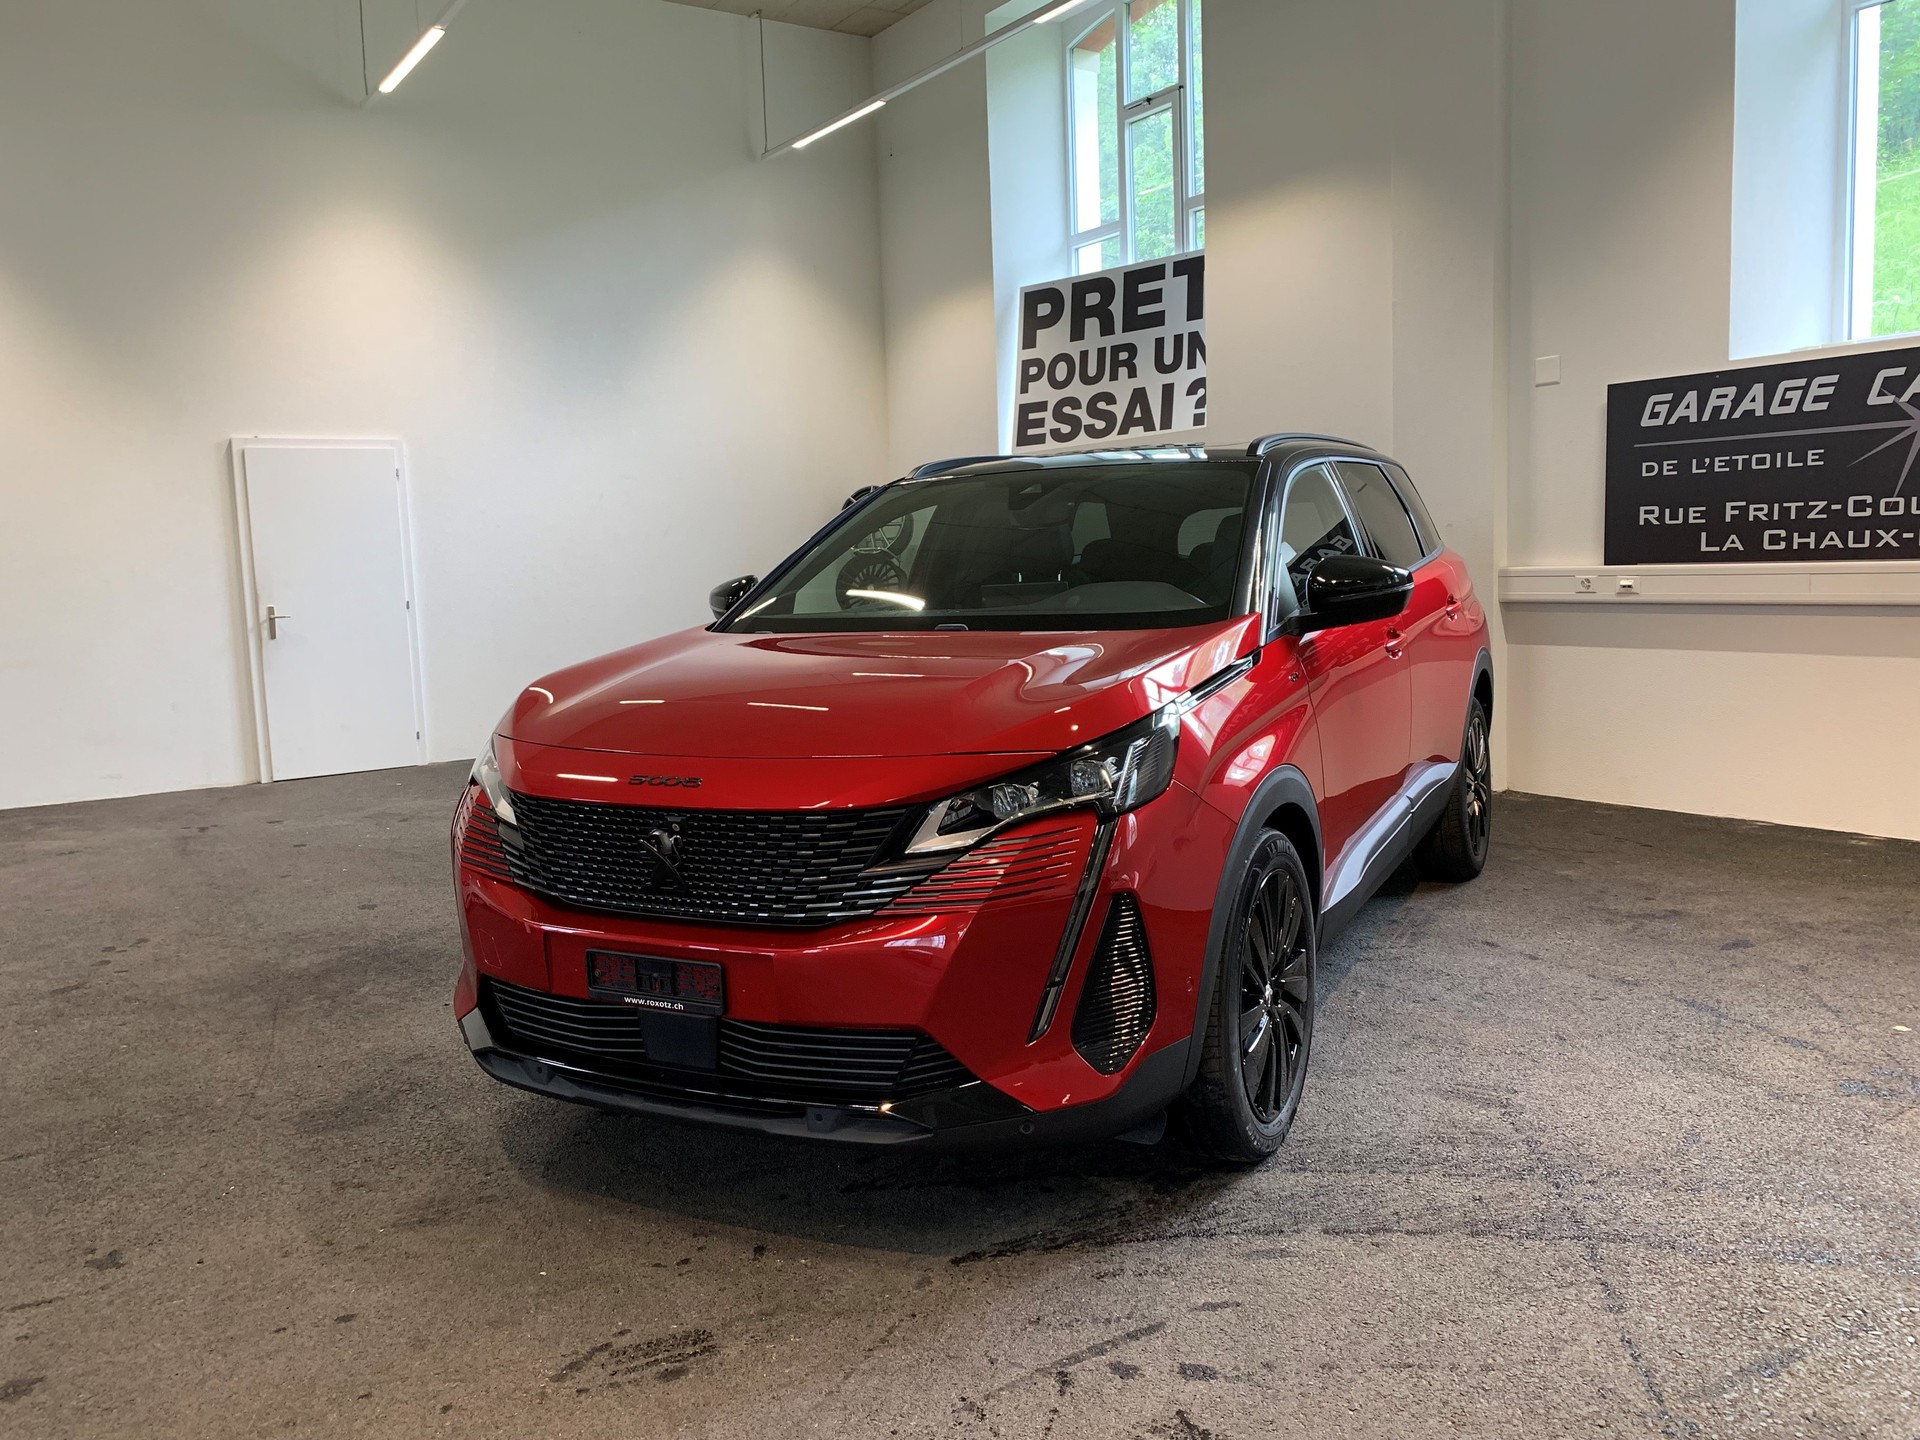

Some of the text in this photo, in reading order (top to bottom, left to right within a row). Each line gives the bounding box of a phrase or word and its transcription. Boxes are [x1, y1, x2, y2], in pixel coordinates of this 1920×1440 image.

[1022, 255, 1204, 350] PRET
[1020, 330, 1206, 394] POUR UN
[1016, 382, 1174, 447] ESSAI
[1640, 374, 1840, 428] GARAGE
[1642, 449, 1825, 477] DE L'ETOILE
[1639, 505, 1706, 526] RUE
[1701, 528, 1920, 552] LA CHAUX-
[628, 775, 702, 788] 5008
[624, 997, 684, 1010] www.roxotz.ch
